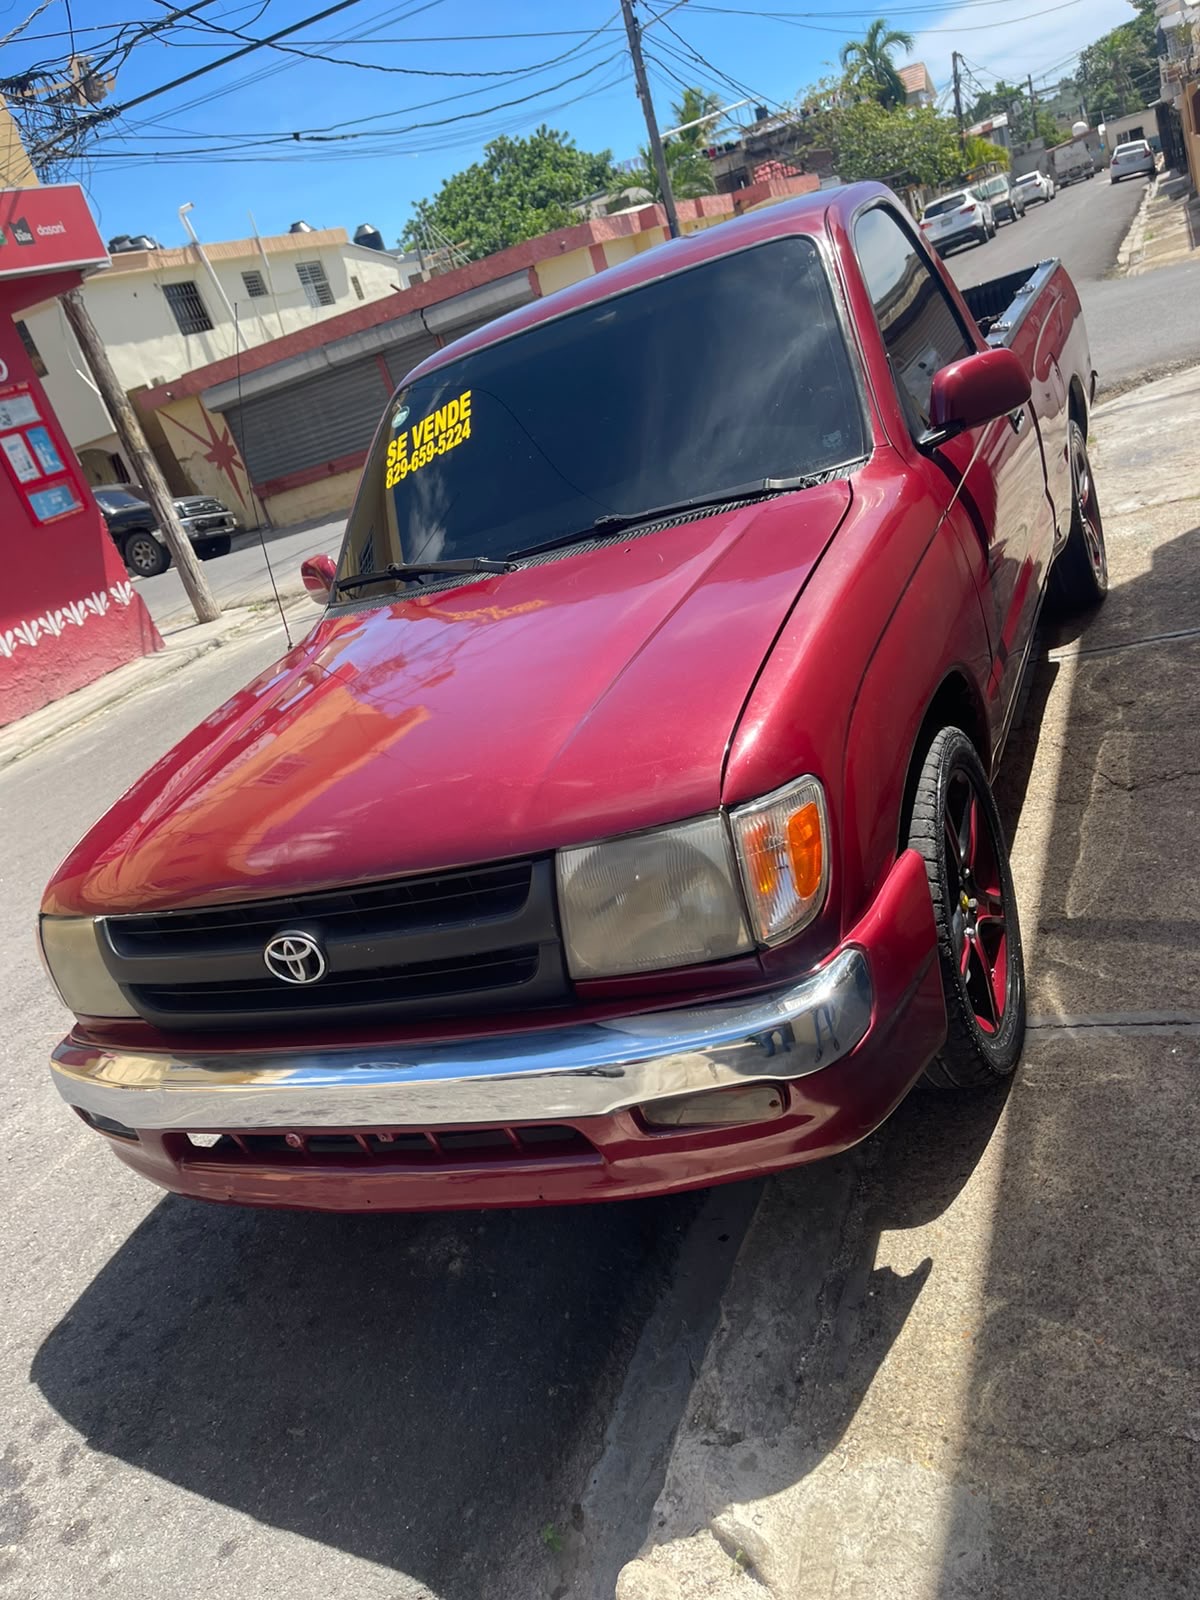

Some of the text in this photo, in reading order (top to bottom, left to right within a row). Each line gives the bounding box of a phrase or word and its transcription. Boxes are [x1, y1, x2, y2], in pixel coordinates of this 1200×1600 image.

[385, 418, 471, 489] 829-659-5224
[386, 390, 472, 467] SE VENDE
